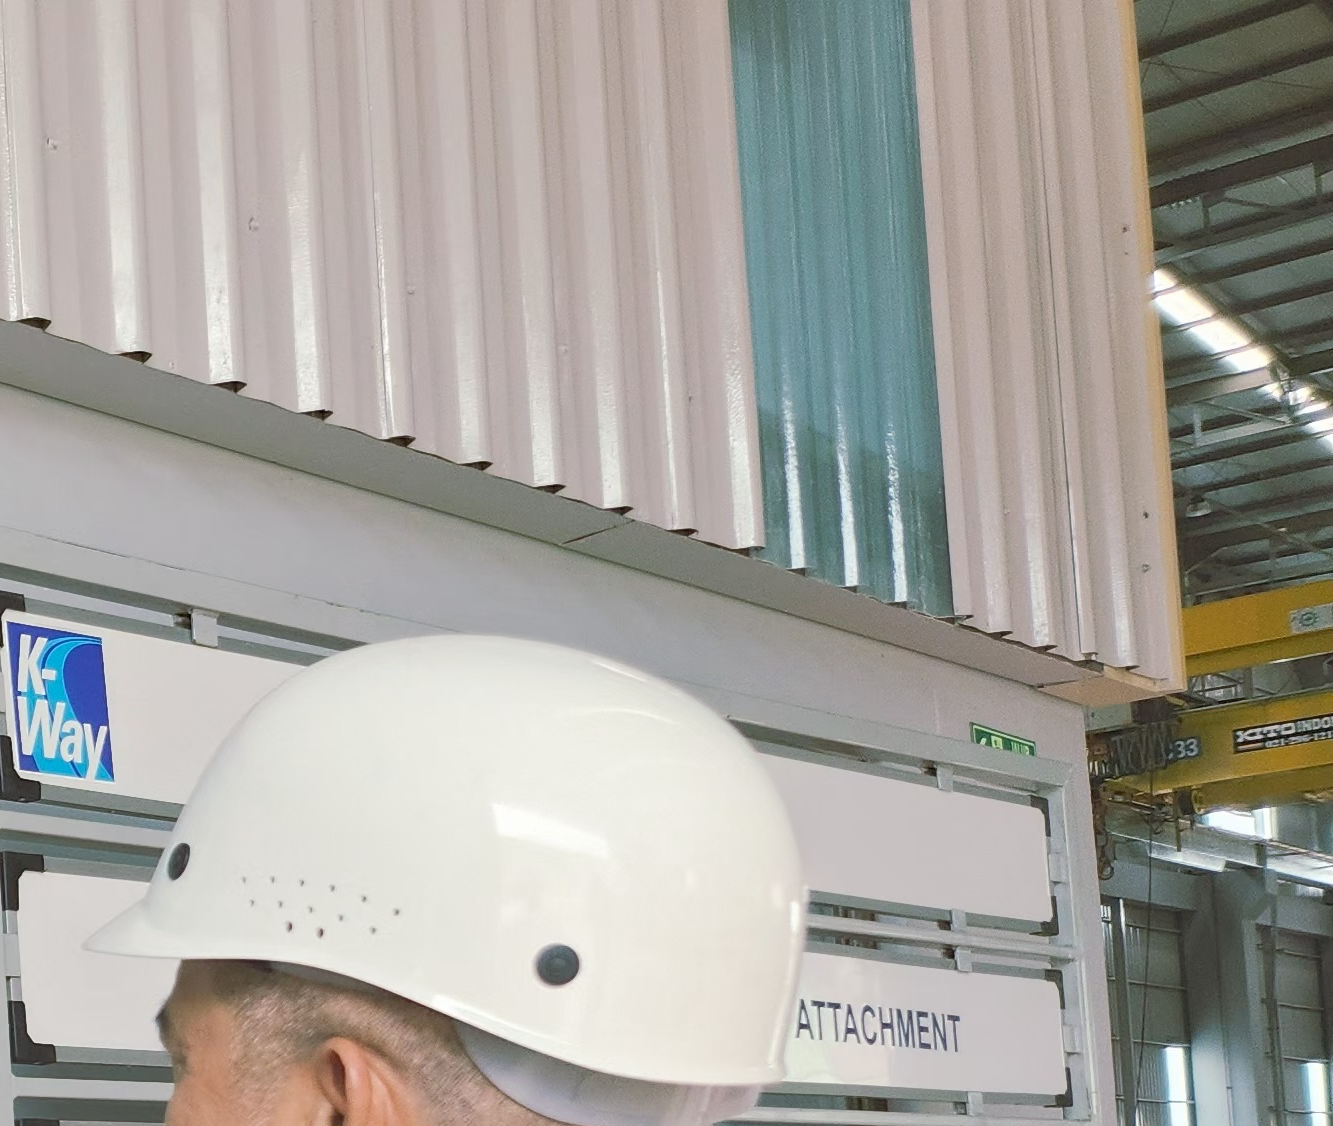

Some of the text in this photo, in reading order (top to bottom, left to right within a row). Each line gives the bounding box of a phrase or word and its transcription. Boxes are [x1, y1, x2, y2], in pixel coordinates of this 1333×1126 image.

[17, 696, 107, 781] Way
[1235, 716, 1333, 743] KITO INDO
[794, 999, 961, 1053] ATTACHMENT
